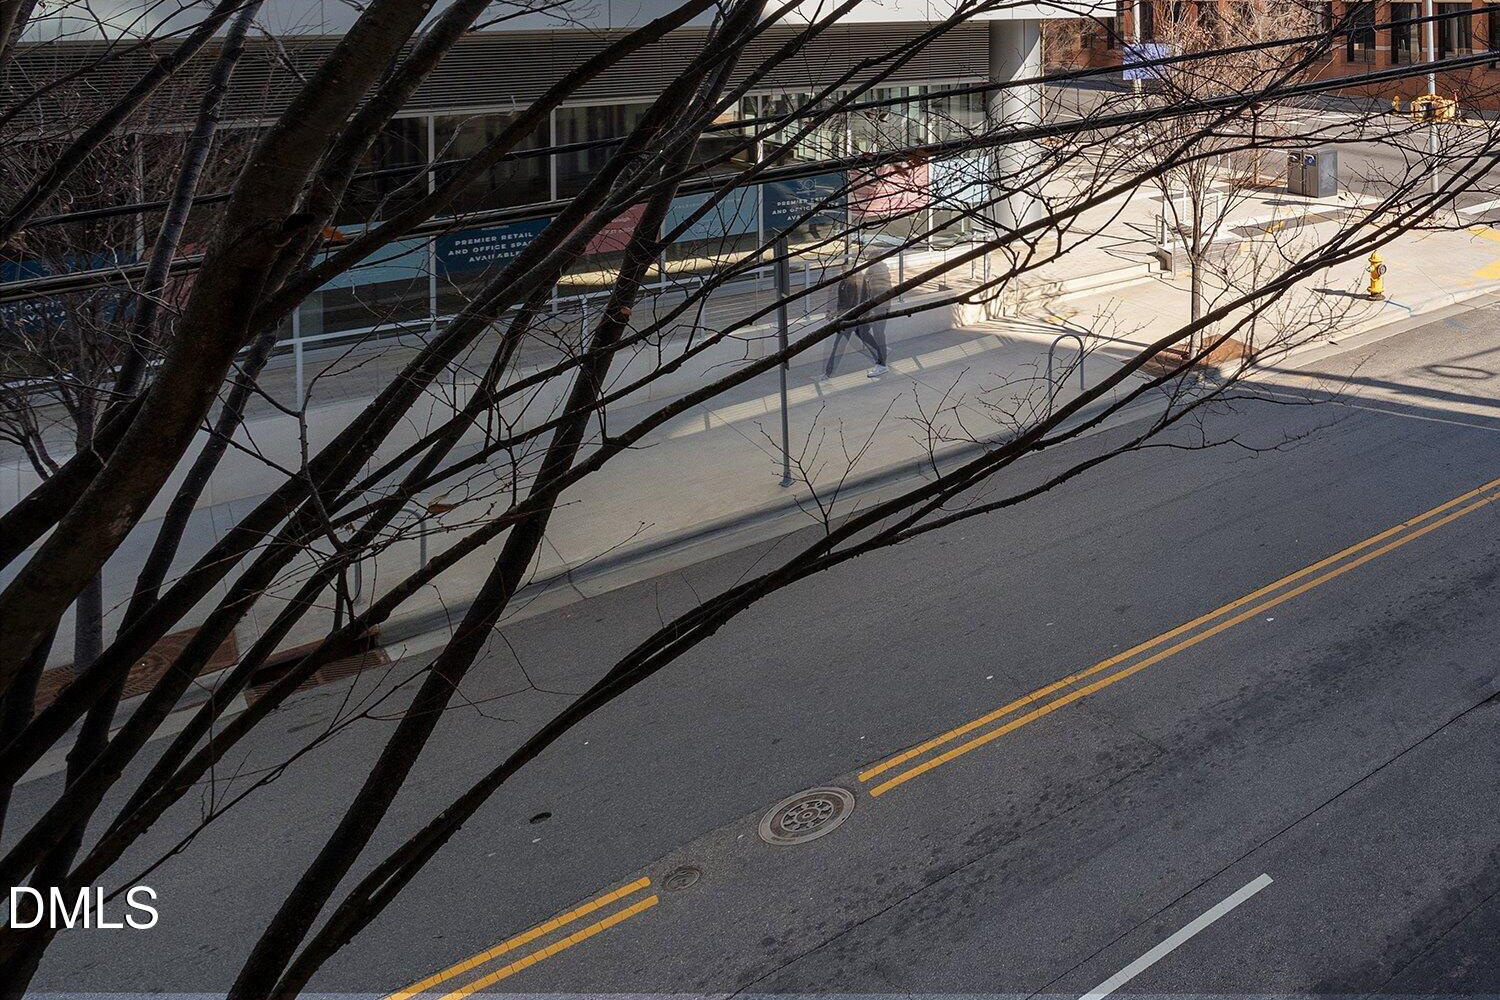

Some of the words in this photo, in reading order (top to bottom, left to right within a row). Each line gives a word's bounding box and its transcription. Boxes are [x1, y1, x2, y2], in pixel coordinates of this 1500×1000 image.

[455, 236, 497, 246] PREMIER
[501, 232, 533, 240] RETAIL
[448, 248, 468, 256] AND
[472, 243, 507, 253] OFFICE
